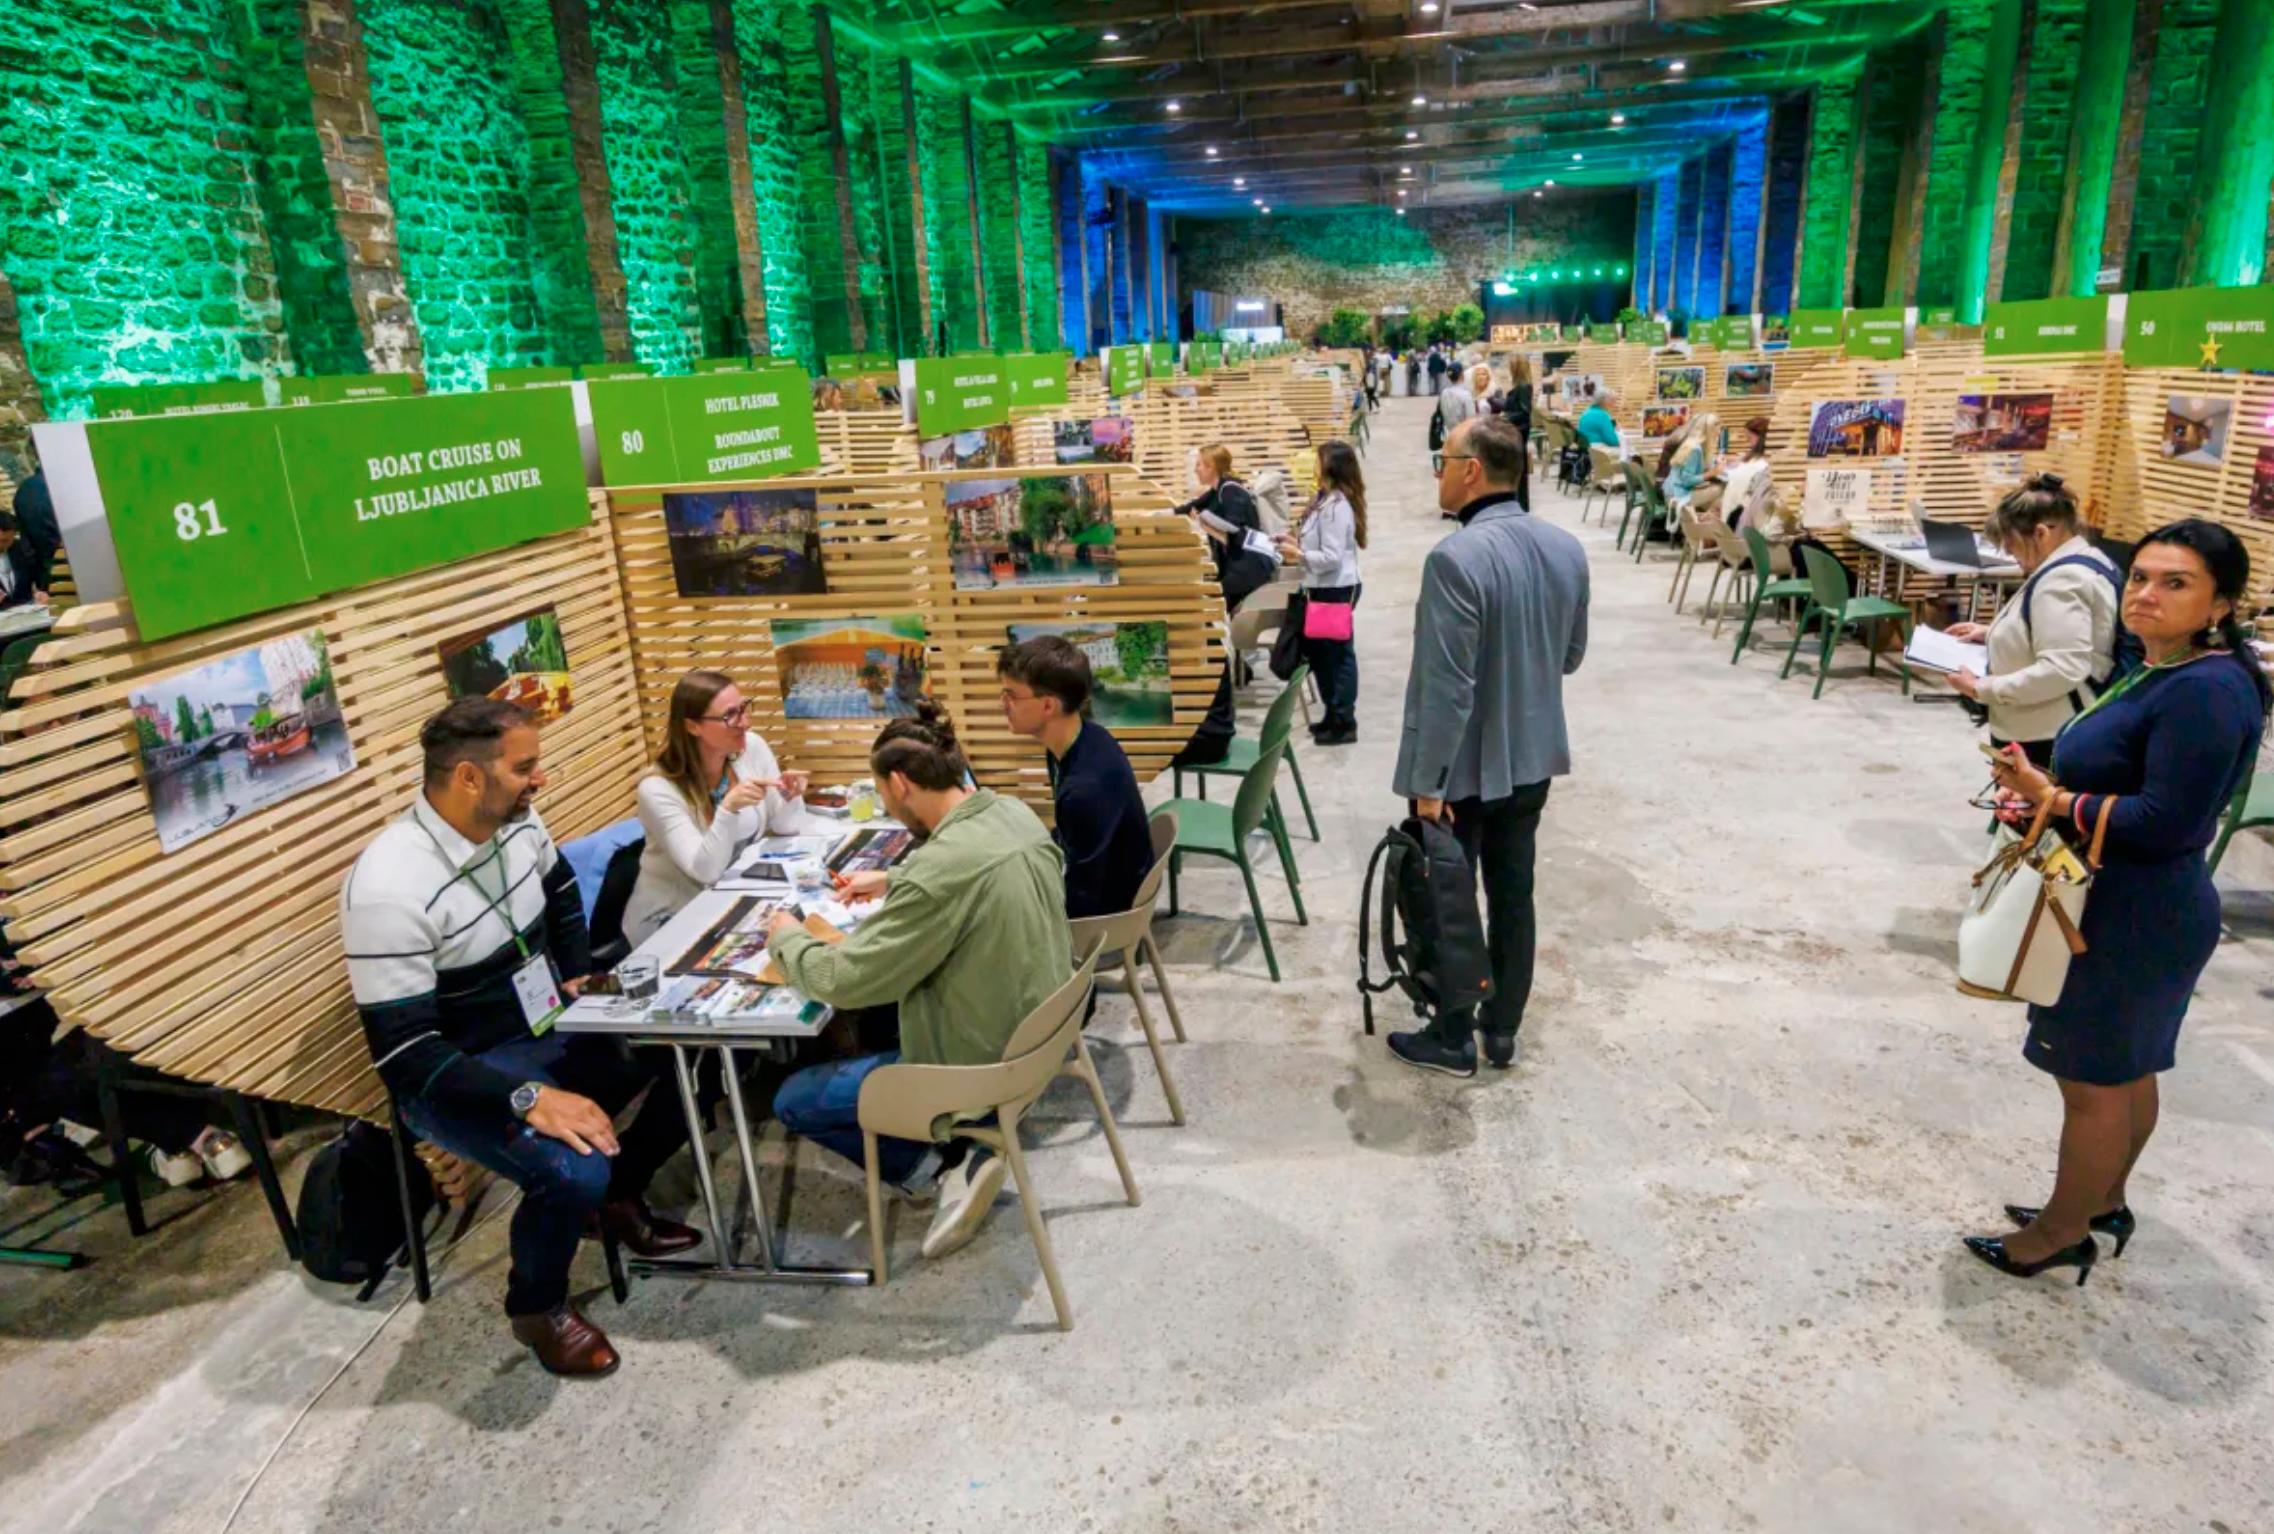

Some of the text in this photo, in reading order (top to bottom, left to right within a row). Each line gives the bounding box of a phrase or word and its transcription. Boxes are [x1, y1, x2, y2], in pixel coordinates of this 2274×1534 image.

[2140, 320, 2156, 335] 50
[704, 396, 740, 414] HOTEL
[621, 429, 644, 455] 80
[714, 426, 780, 449] ROUNDABOUT
[367, 438, 522, 480] BOAT CRUISE ON
[707, 448, 772, 474] EXPERIENCES
[354, 468, 542, 521] LJUBLJANICA RIVER
[173, 498, 228, 541] 81
